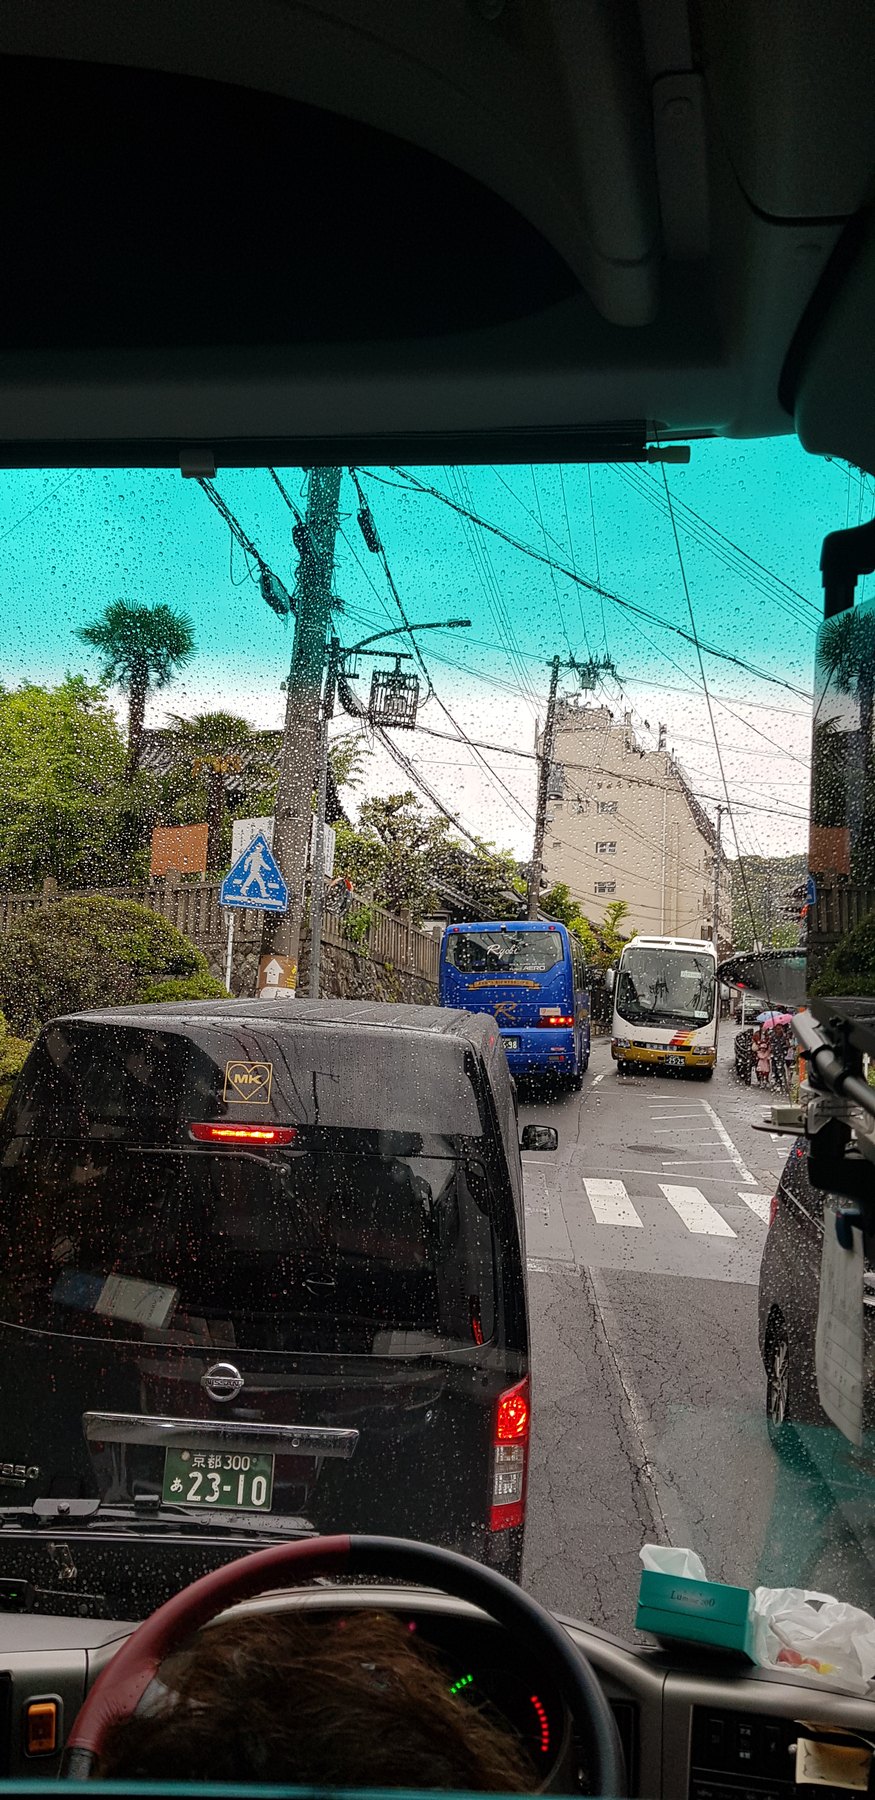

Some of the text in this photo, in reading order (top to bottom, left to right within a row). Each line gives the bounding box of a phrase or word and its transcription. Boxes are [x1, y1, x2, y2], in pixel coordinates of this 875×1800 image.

[234, 1073, 263, 1085] MK
[170, 1471, 267, 1506] あ 23-10
